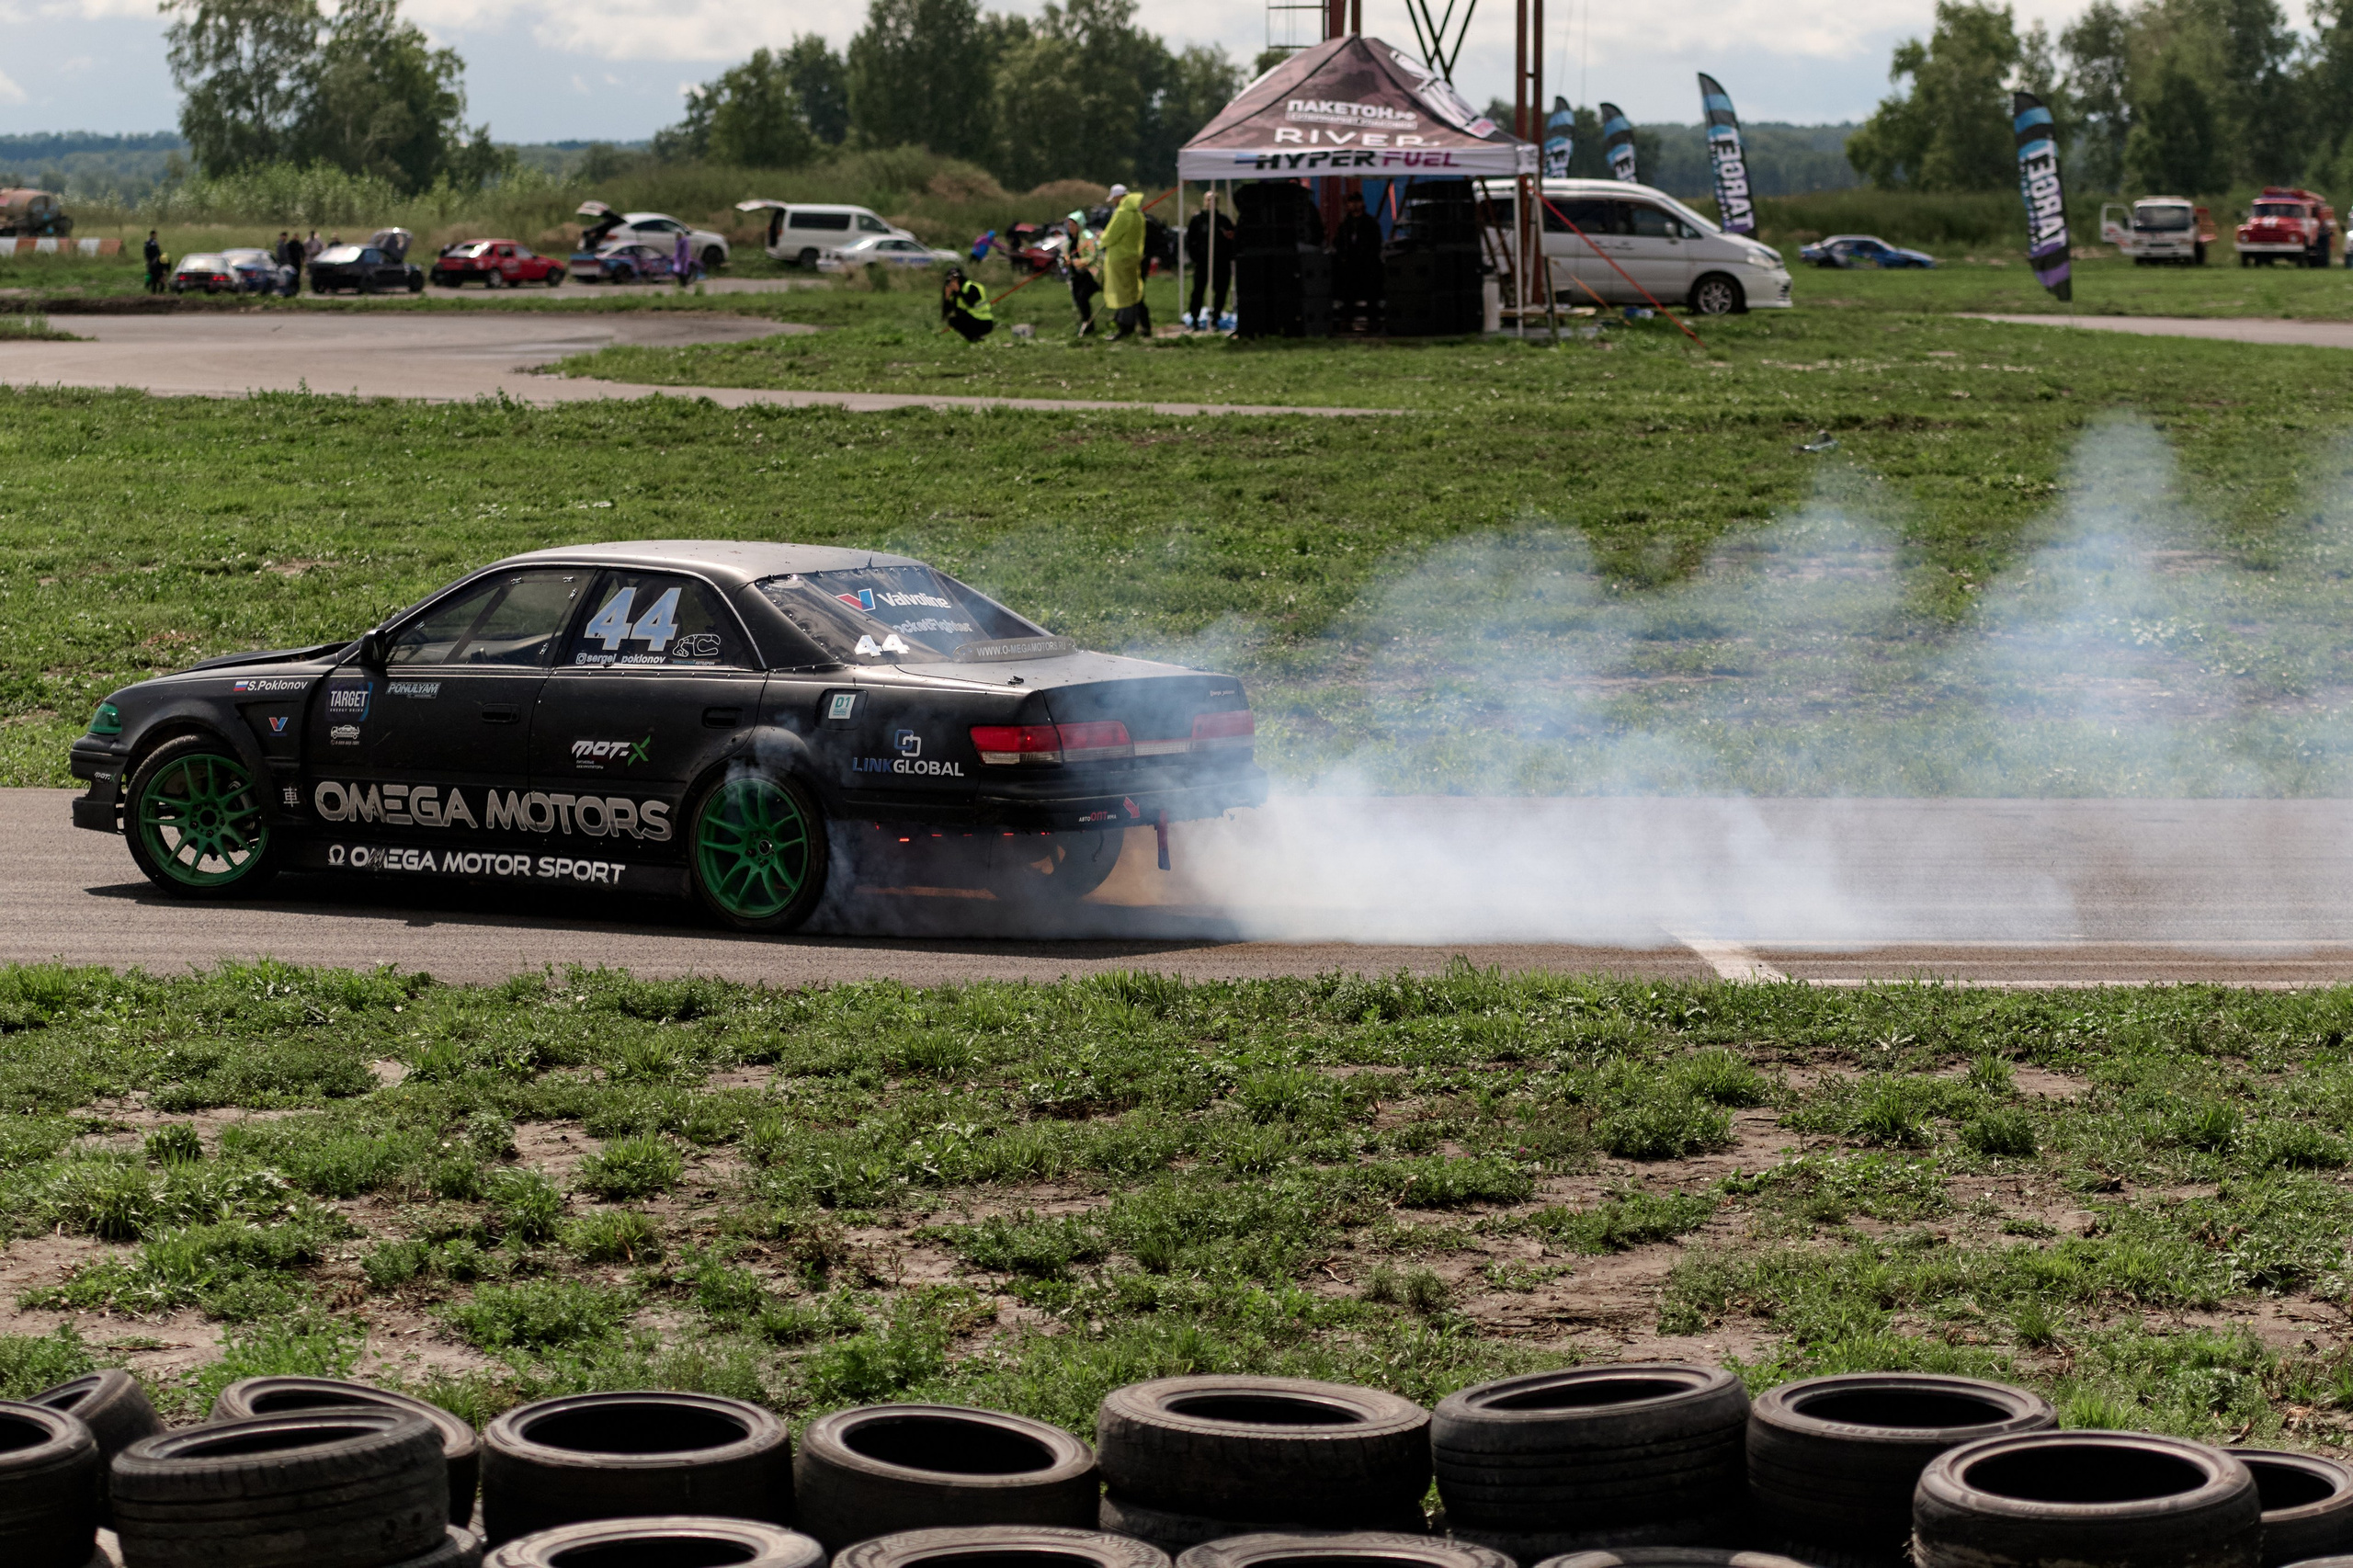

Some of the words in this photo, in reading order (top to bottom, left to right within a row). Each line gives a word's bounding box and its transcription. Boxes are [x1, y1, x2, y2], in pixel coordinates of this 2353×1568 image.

[1274, 127, 1440, 147] RIVER
[876, 591, 952, 609] Valvoline
[584, 586, 682, 652] 44
[892, 618, 973, 634] ocketFighter
[855, 633, 911, 657] 44
[976, 641, 1066, 657] WWW.O-MEGAMOTORS.RU
[246, 679, 309, 691] S.Poklonov
[330, 690, 369, 707] TARGET
[835, 696, 851, 709] D1
[571, 734, 651, 767] MOT-X
[852, 756, 965, 778] LINKGLOBAL
[282, 786, 301, 808] 車
[314, 780, 478, 829] OMEGA
[486, 789, 673, 842] MOTORS
[350, 846, 438, 872] OMEGA
[441, 852, 531, 877] MOTOR
[538, 856, 626, 884] SPORT
